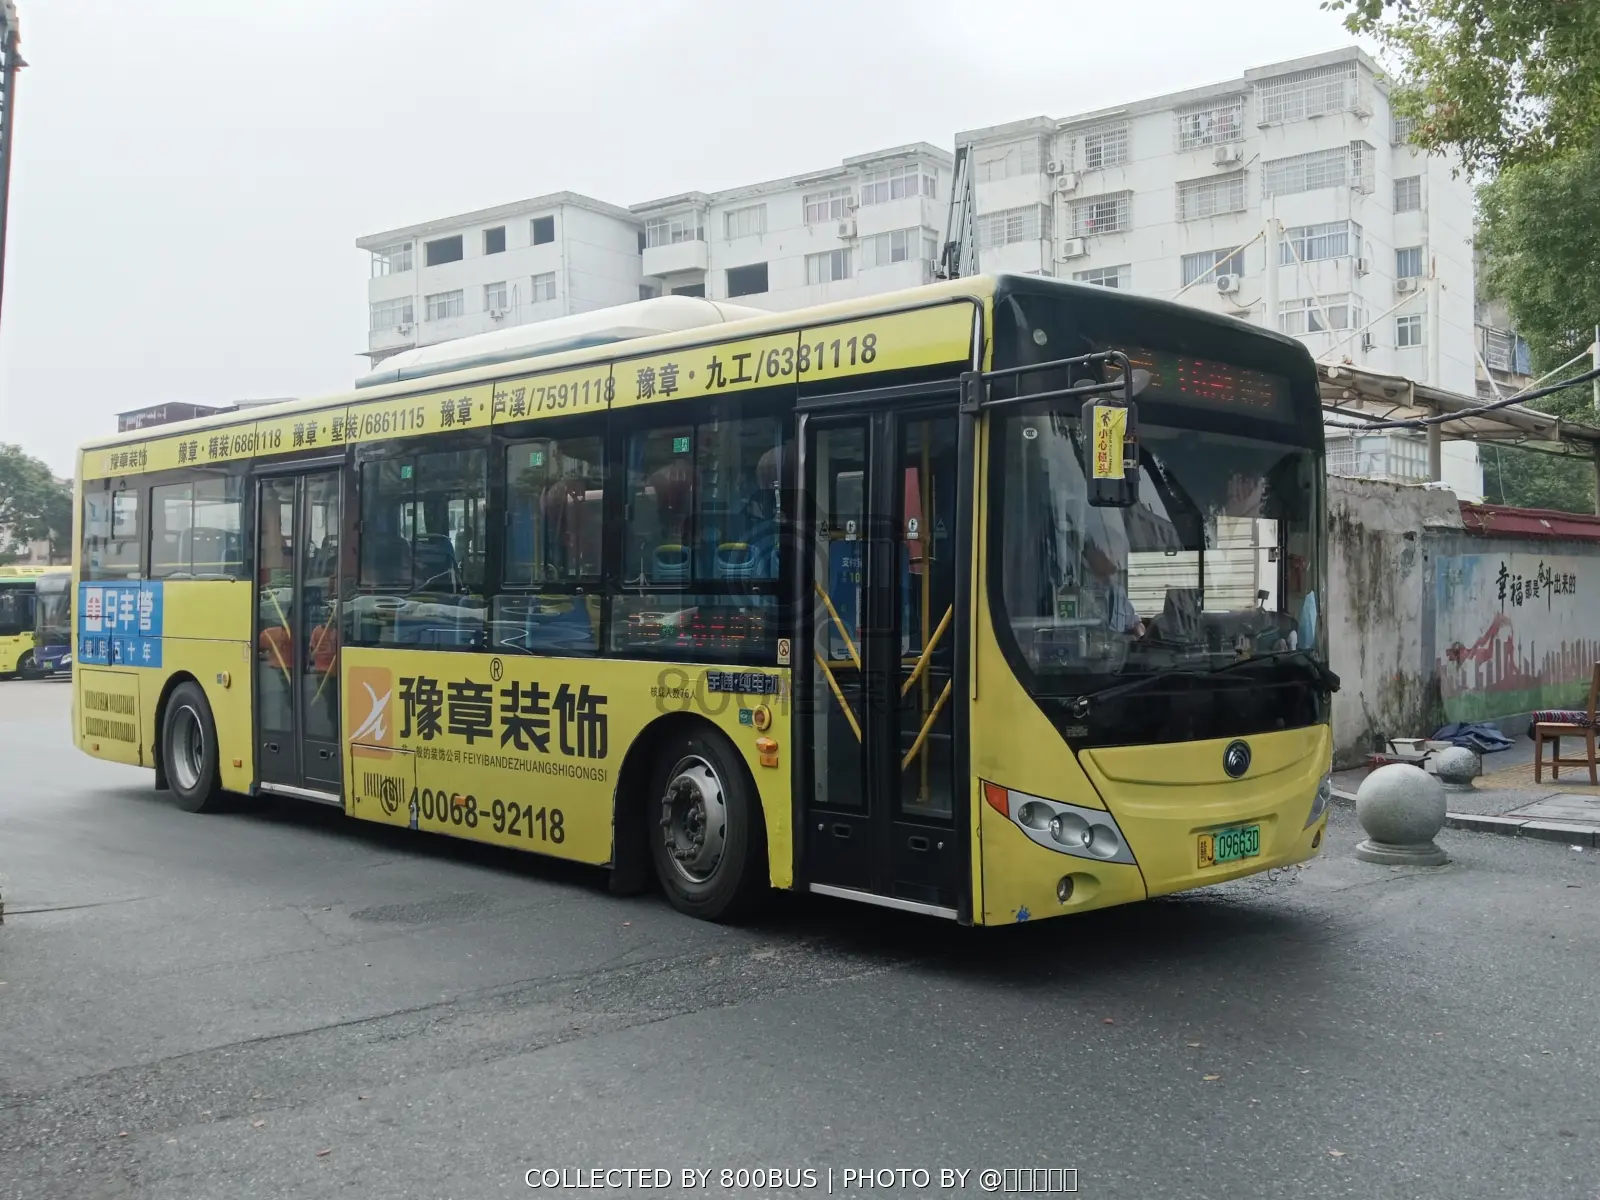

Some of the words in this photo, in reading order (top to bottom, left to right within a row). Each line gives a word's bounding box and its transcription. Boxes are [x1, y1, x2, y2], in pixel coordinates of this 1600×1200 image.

[110, 448, 147, 471] 豫章装饰
[104, 588, 154, 631] 日丰管
[399, 675, 608, 760] 豫章装饰
[401, 744, 461, 764] 非般的装饰公司
[463, 755, 607, 783] FEIYIBANDEZHUANGSHIGONGSI
[409, 787, 565, 844] 40068-92118
